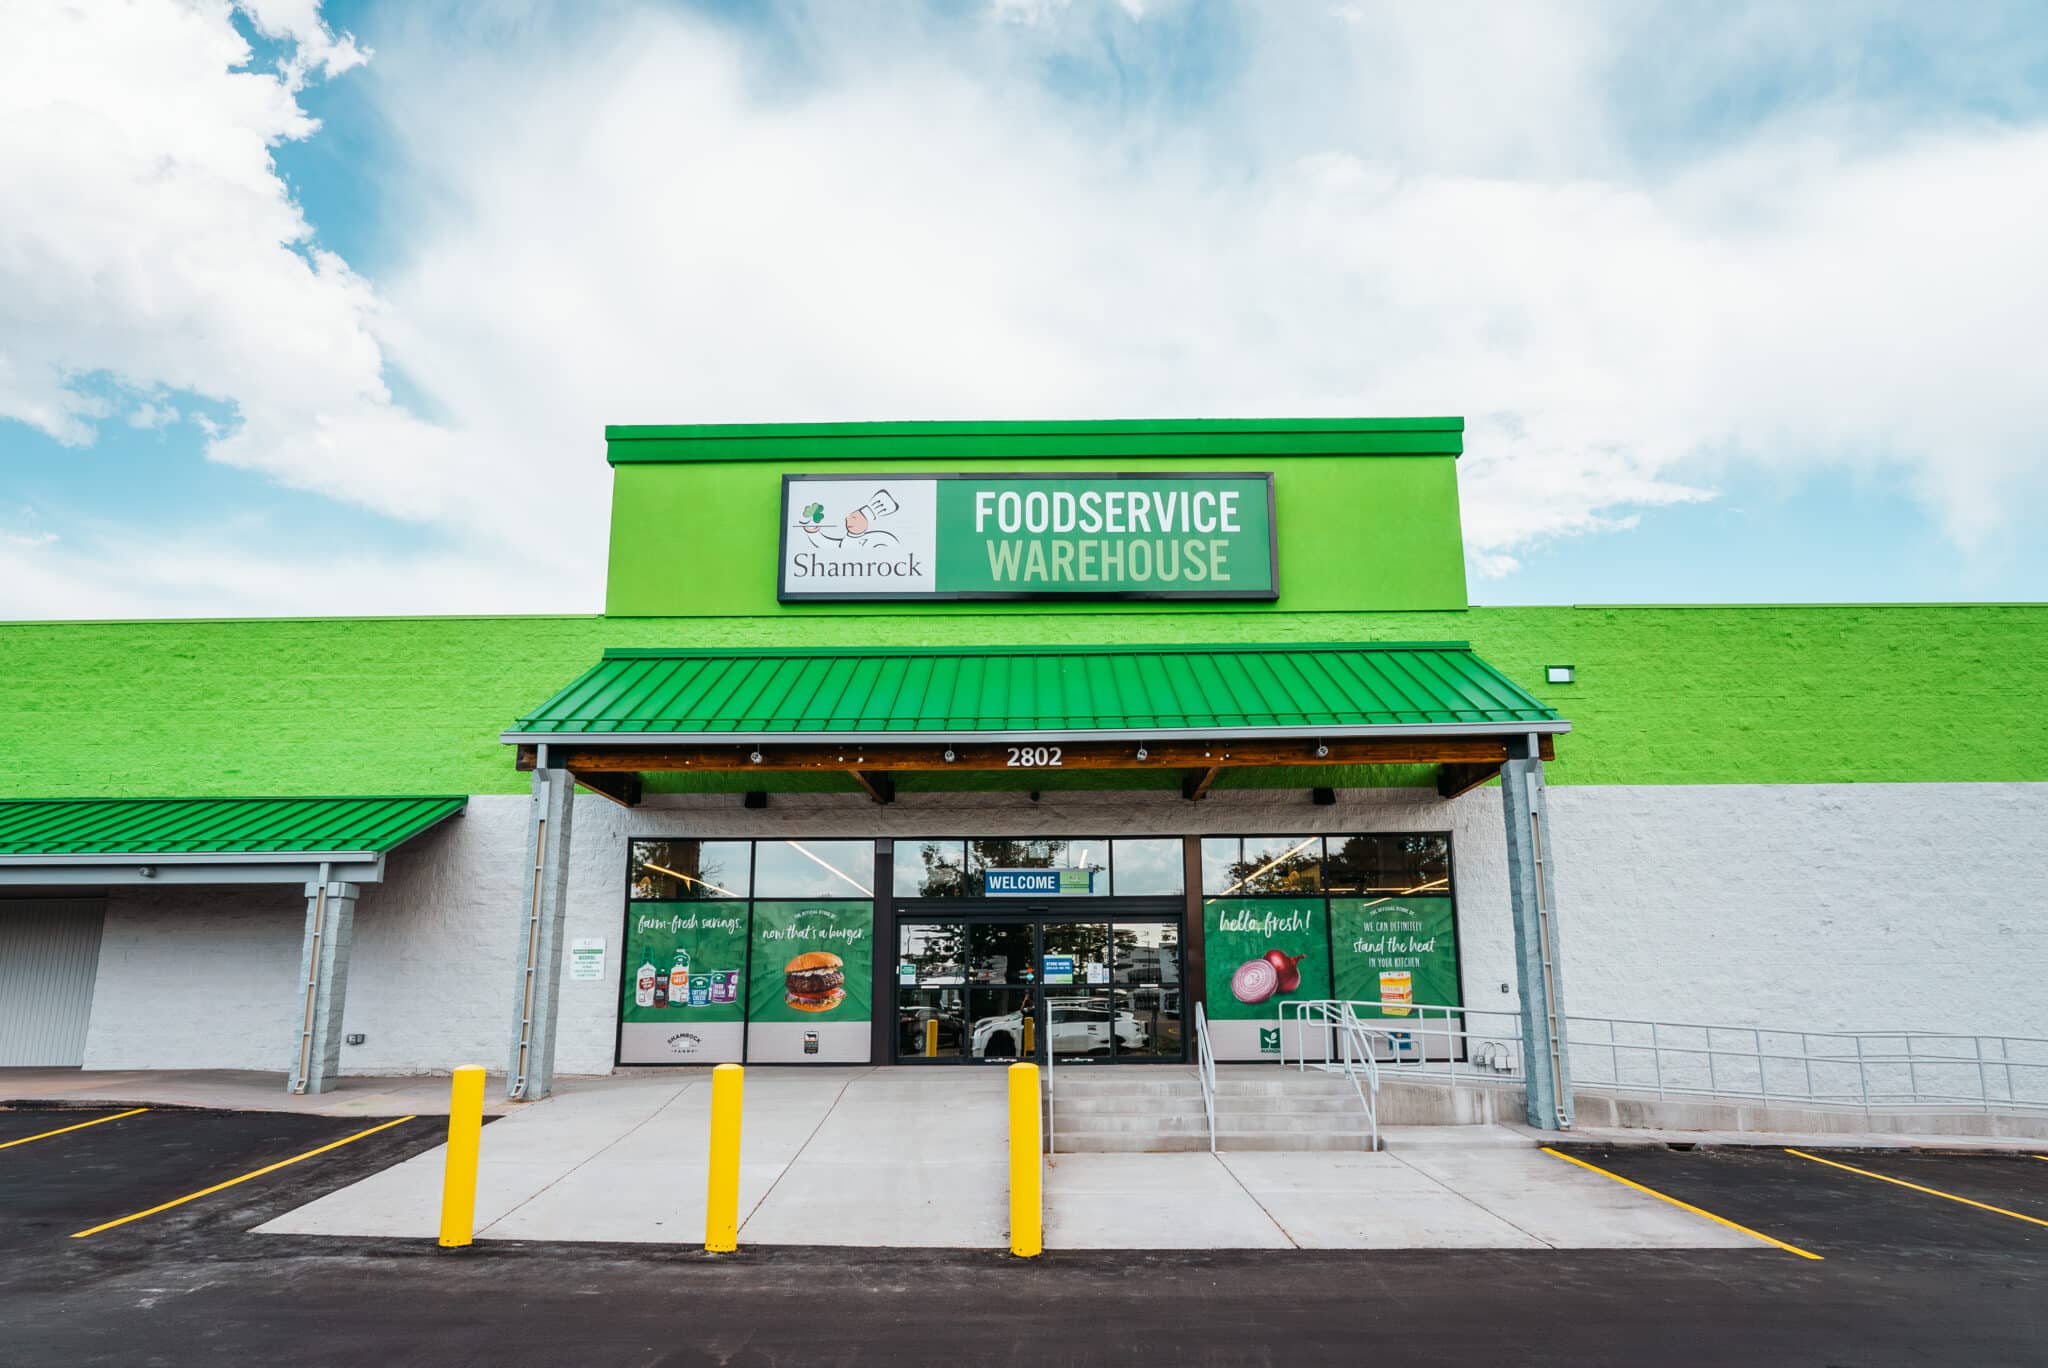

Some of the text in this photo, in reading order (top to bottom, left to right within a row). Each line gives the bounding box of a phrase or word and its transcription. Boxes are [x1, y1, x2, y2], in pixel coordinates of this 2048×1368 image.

[975, 491, 1241, 534] FOODSERVICE
[793, 553, 923, 579] Shamrock
[986, 539, 1231, 582] WAREHOUSE
[1006, 747, 1063, 768] 2802
[989, 875, 1056, 890] WELCOME
[638, 914, 742, 935] farm-fresh savings.
[1265, 909, 1312, 938] fresh!
[1363, 921, 1374, 932] WE
[1375, 921, 1388, 932] CAN
[762, 923, 865, 946] now that's a burger.
[1353, 935, 1437, 956] stand the heat
[1368, 956, 1376, 968] IN
[1378, 956, 1393, 968] YOUR
